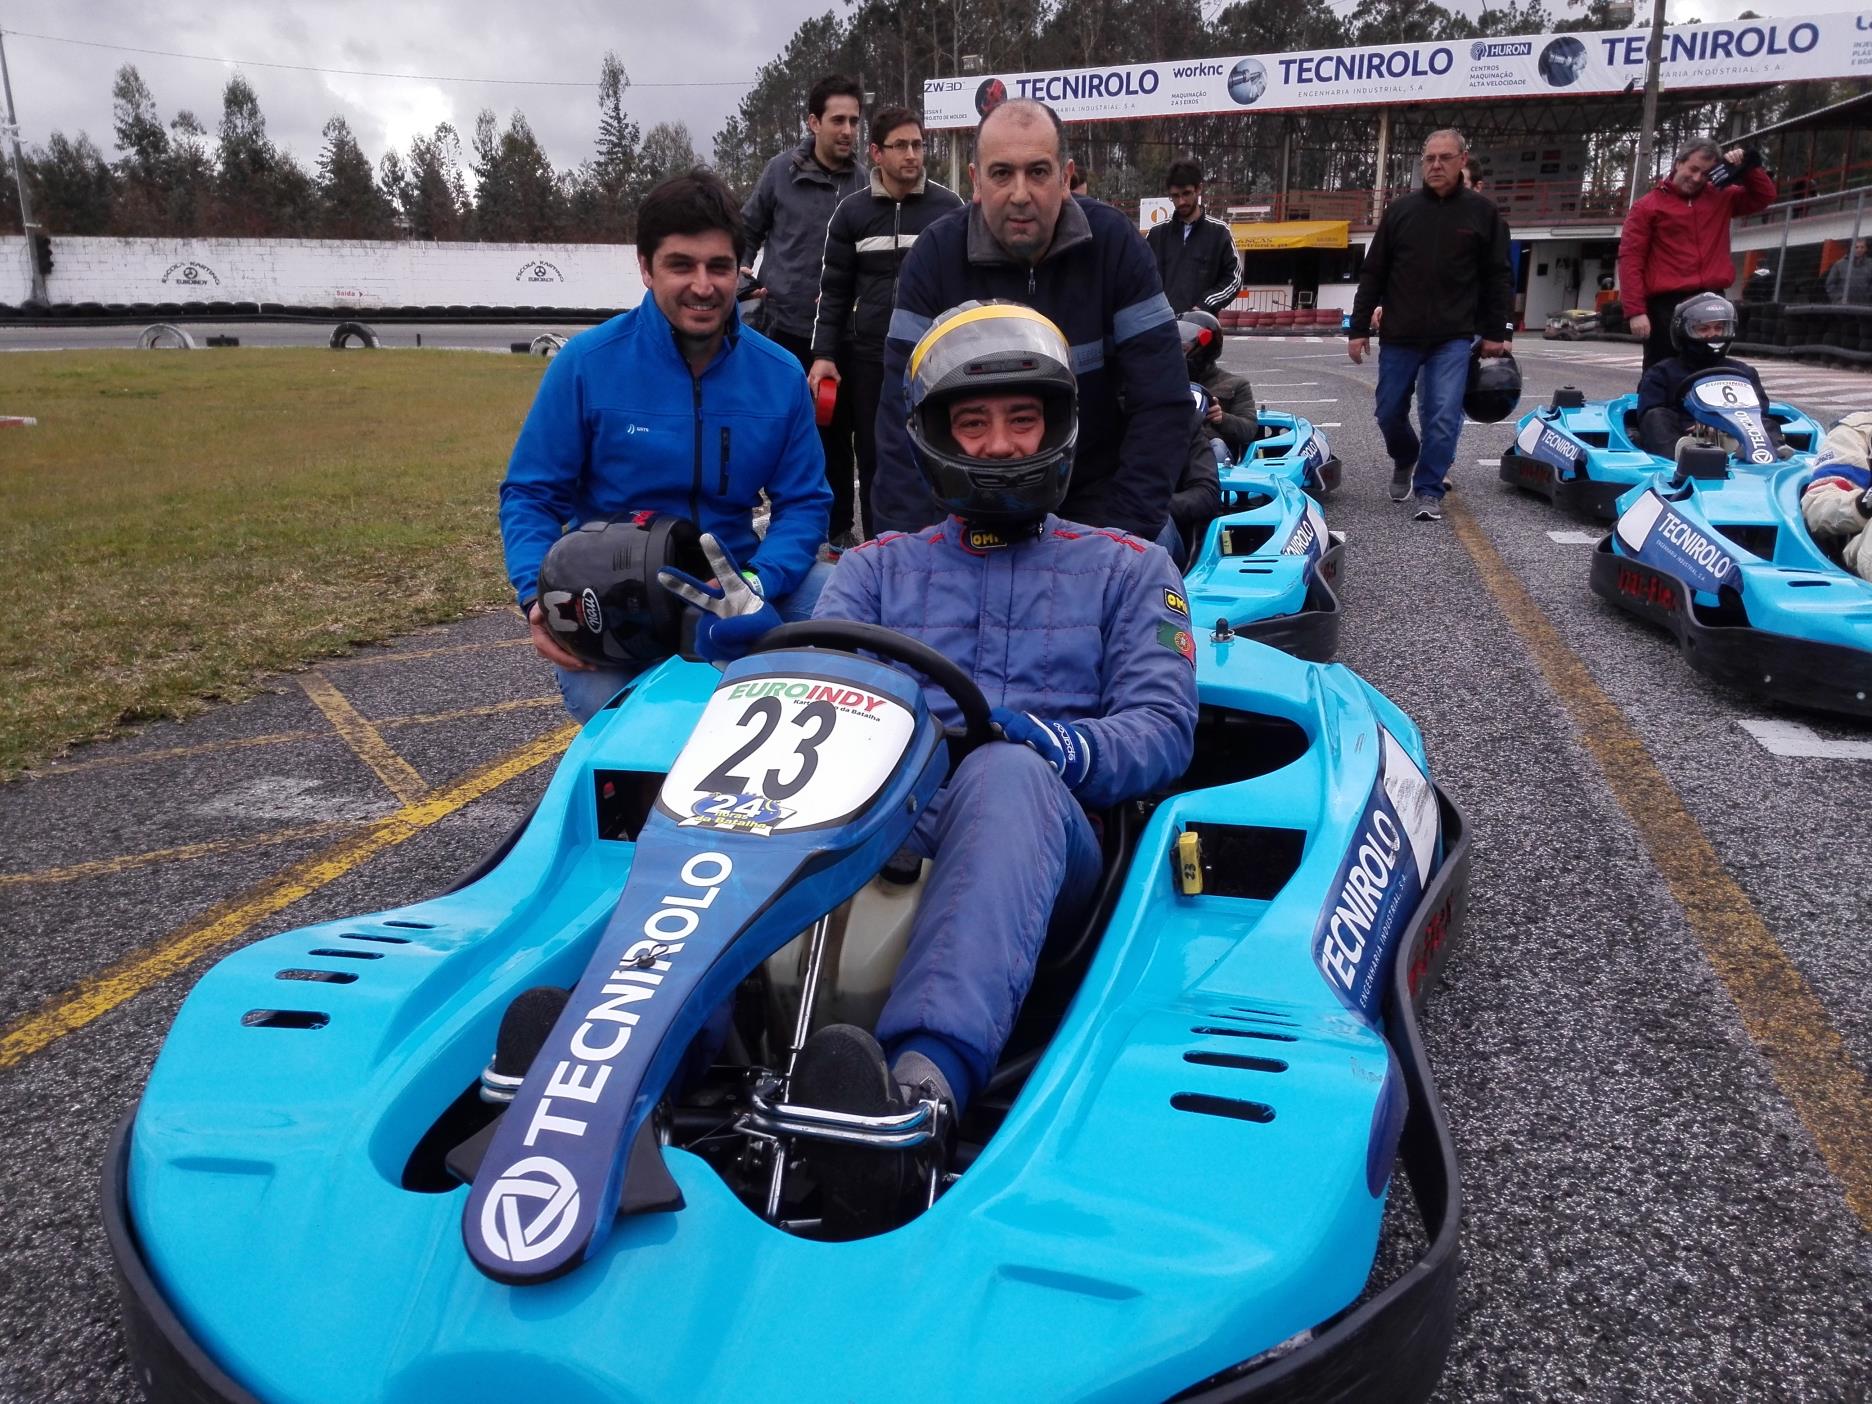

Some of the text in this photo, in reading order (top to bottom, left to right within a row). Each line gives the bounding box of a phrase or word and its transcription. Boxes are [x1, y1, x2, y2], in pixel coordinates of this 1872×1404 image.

[1490, 44, 1529, 55] HURON
[1172, 62, 1224, 79] worknc
[1278, 47, 1454, 85] TECNIROLO
[1470, 64, 1499, 72] CENTROS
[1016, 69, 1159, 102] TECNIROLO
[1469, 72, 1513, 80] MAQUINAÇÃO
[1487, 79, 1527, 87] VELOCIDADE
[1171, 91, 1207, 99] MAQUINAÇÃO
[1298, 88, 1350, 98] ENGENHARIA
[1721, 385, 1738, 404] 6
[972, 533, 1000, 545] OM
[1658, 512, 1731, 579] TECNIROLO
[1167, 593, 1188, 613] OM
[727, 682, 888, 713] EUROINDY
[840, 704, 850, 713] da
[851, 708, 881, 722] Batalha
[693, 695, 837, 801] 23
[704, 794, 766, 818] 24
[695, 815, 767, 829] da Batalha
[1319, 809, 1401, 991] TECNIROLO
[1359, 944, 1384, 1009] ENGENHARIA
[523, 851, 733, 1146] TECNIROLO
